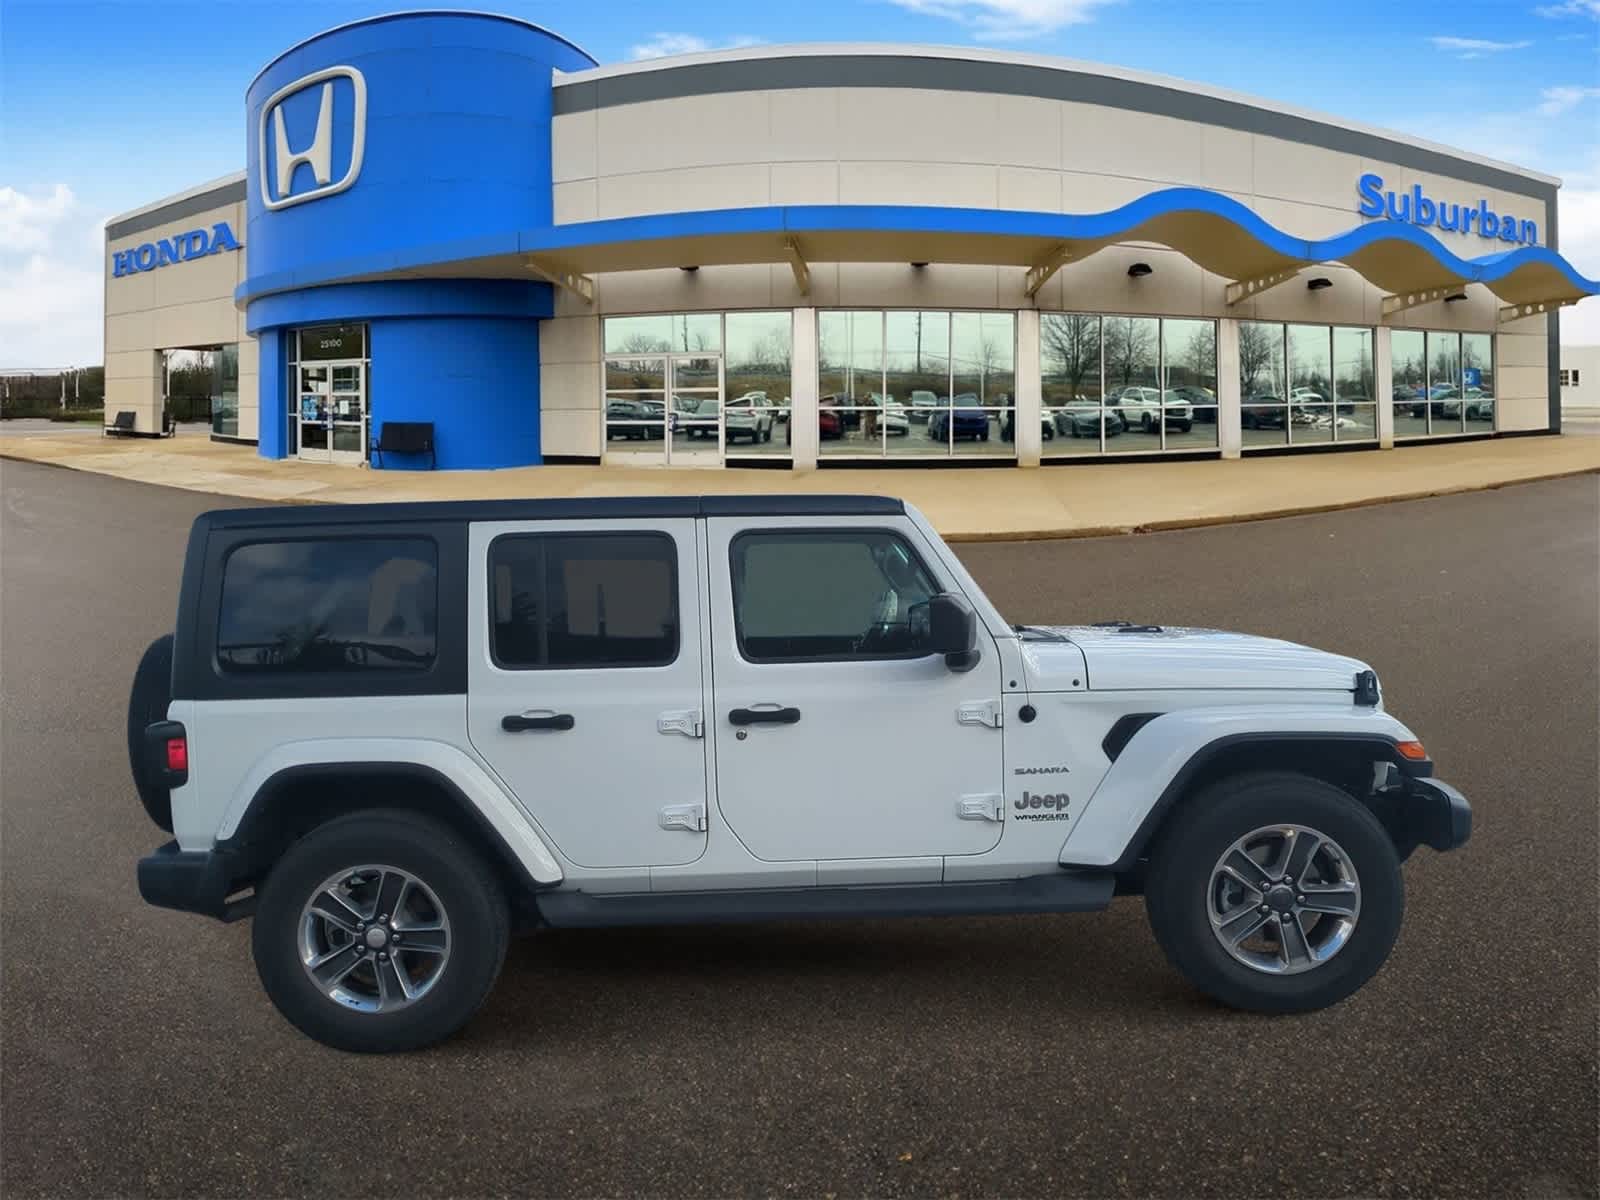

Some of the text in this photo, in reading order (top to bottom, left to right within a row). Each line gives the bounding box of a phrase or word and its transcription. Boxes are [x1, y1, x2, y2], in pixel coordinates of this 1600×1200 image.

[1358, 173, 1537, 246] Suburban
[112, 221, 242, 278] HONDA
[1014, 766, 1070, 775] SAHARA
[1014, 791, 1070, 811] Jeep
